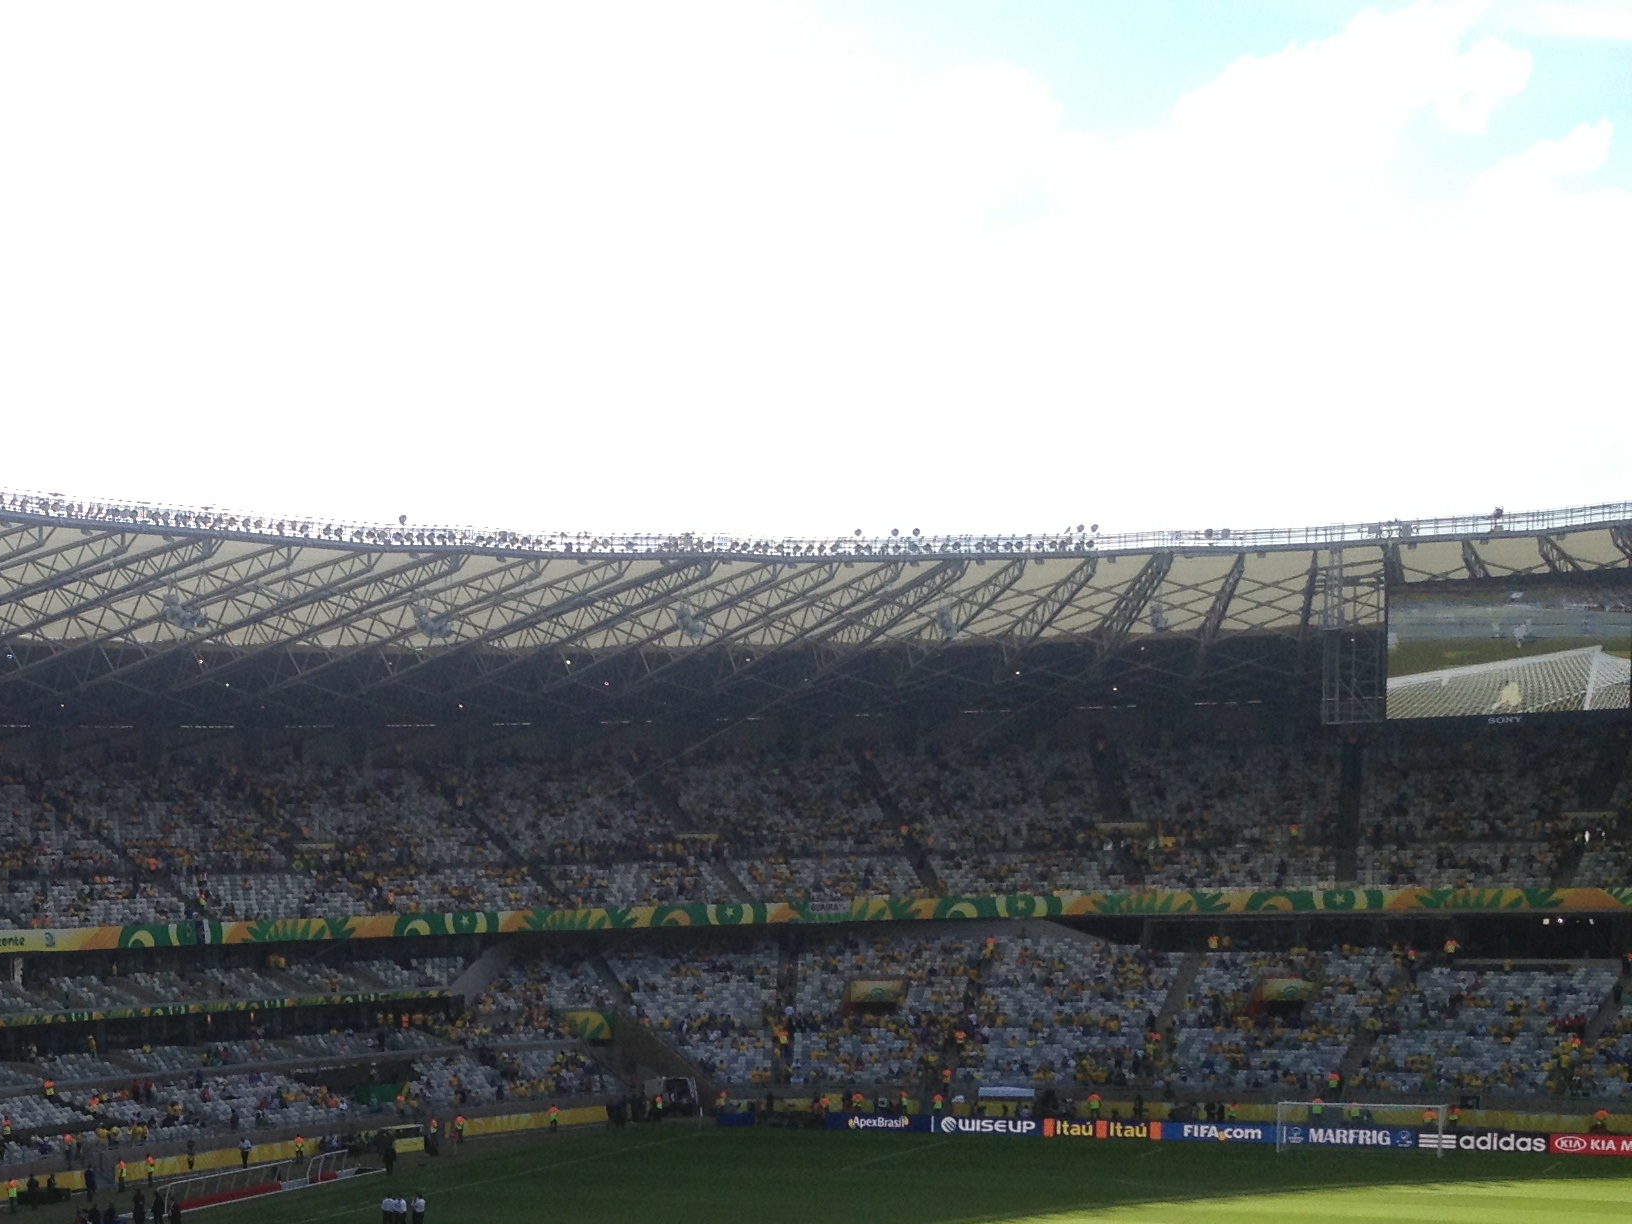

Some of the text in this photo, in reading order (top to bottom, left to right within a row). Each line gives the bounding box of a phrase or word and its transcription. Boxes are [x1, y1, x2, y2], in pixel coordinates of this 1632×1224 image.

[1487, 716, 1522, 724] SONY
[853, 1115, 904, 1128] ApexBrasil
[1056, 1120, 1094, 1137] Itaú
[1109, 1121, 1147, 1138] Itaú
[1183, 1124, 1262, 1141] FIFA.com
[1309, 1128, 1391, 1146] MARFRIG
[1459, 1132, 1547, 1152] adidas
[1590, 1138, 1617, 1151] KIA
